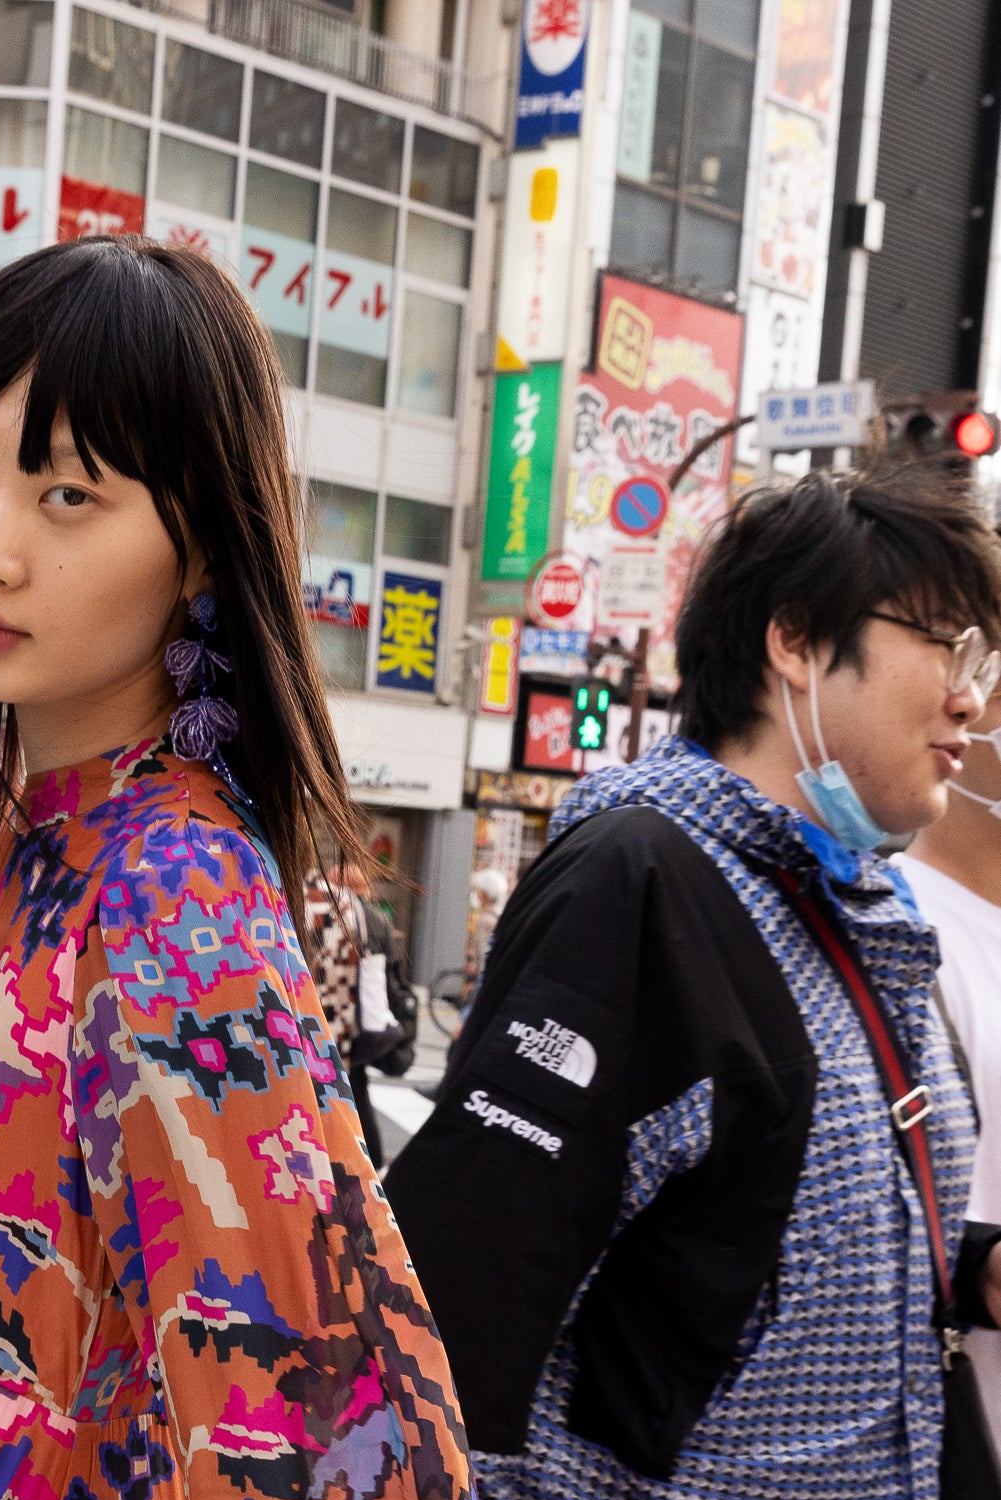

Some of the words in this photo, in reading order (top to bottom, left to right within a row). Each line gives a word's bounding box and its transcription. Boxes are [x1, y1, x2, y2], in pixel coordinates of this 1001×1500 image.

[247, 246, 391, 322] アイフル
[376, 584, 440, 680] 薬
[506, 1021, 573, 1061] NORTH
[515, 1041, 563, 1073] FACE
[541, 1018, 578, 1046] THE
[463, 1090, 563, 1152] Supreme
